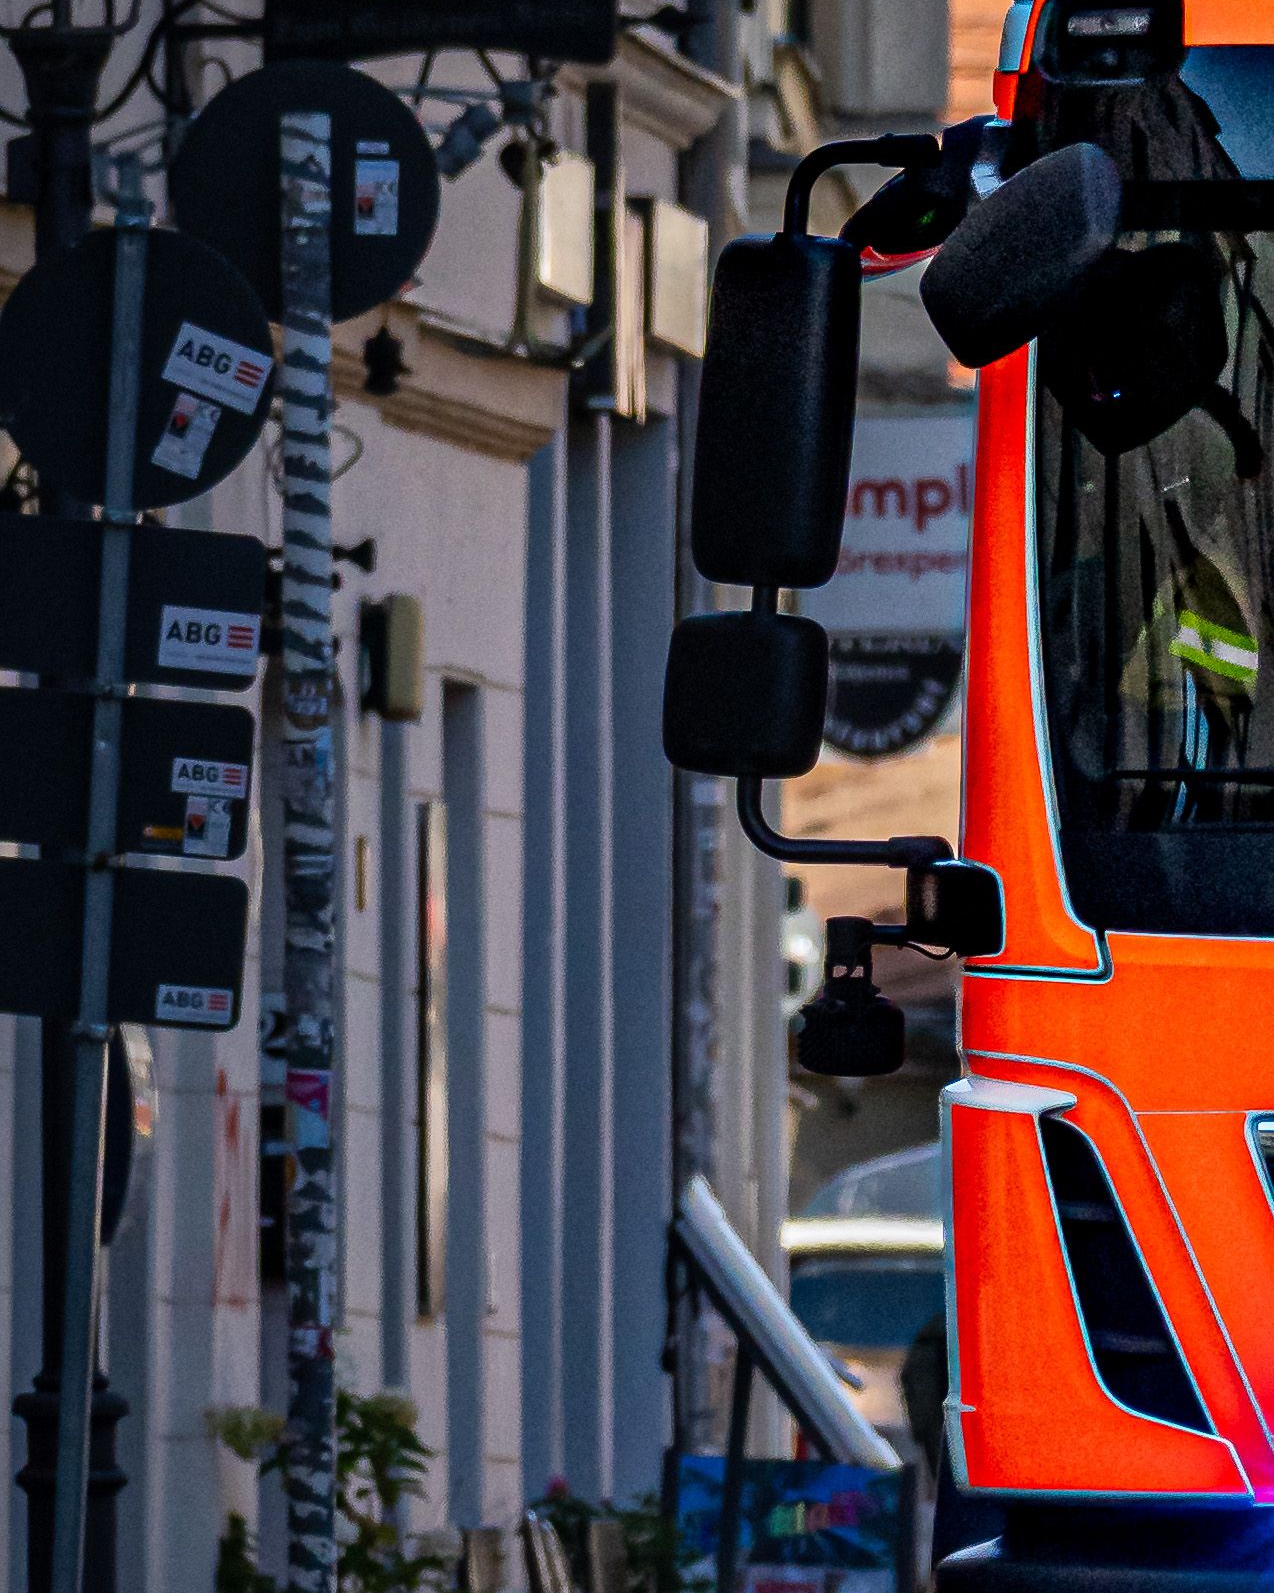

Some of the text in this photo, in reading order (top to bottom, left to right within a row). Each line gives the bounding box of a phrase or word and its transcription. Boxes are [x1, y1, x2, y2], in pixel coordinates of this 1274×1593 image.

[177, 339, 233, 376] ABG
[165, 620, 222, 646] ABG
[177, 763, 219, 784] ABG
[163, 991, 204, 1009] ABG
